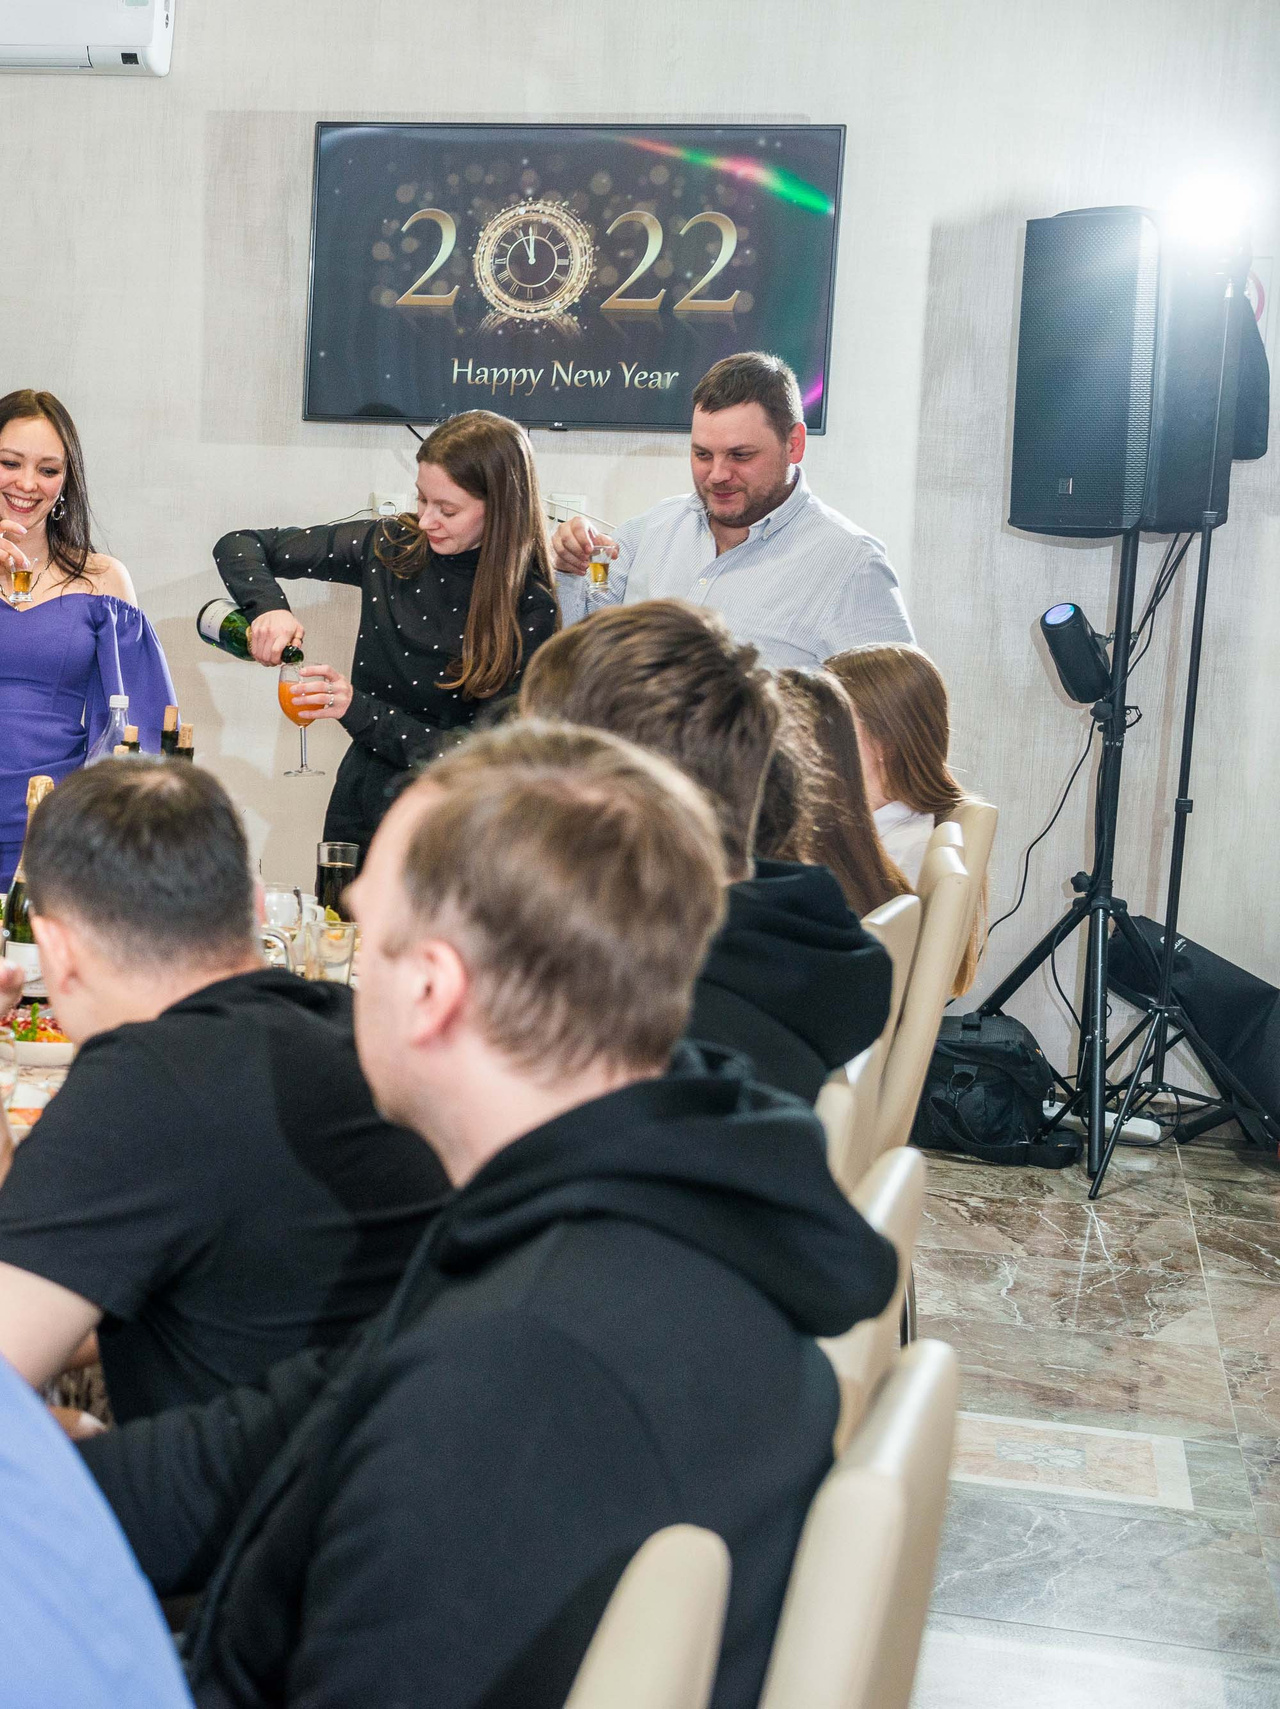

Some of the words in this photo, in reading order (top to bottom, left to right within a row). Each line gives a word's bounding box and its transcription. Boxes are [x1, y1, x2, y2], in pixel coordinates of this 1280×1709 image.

[451, 357, 544, 396] Happy
[551, 360, 611, 388] New
[618, 361, 680, 390] Year
